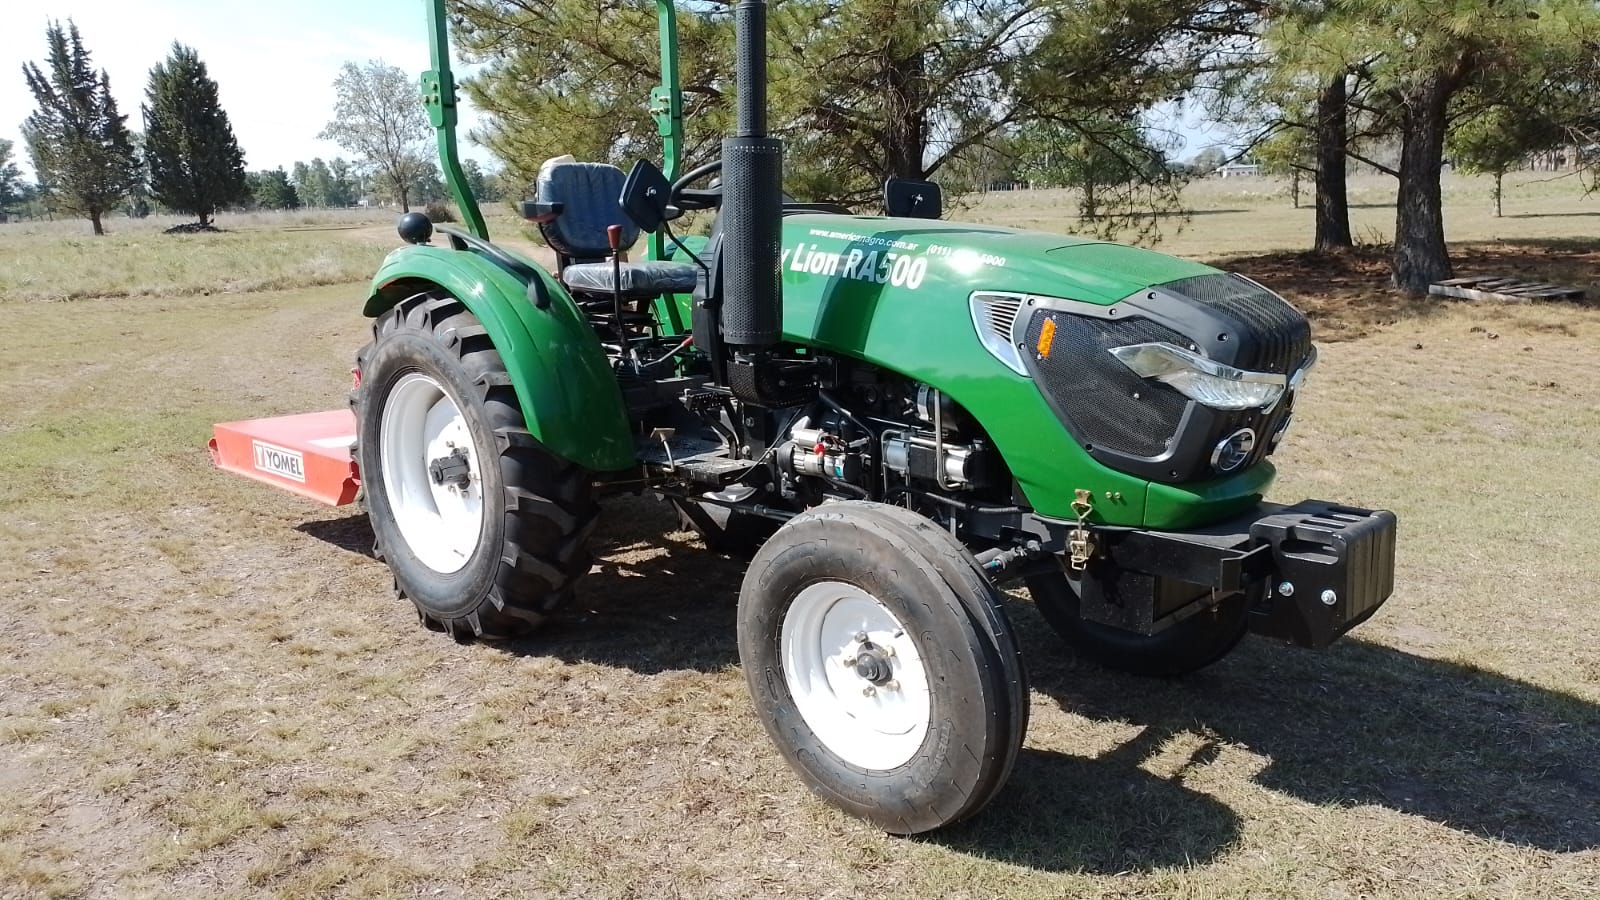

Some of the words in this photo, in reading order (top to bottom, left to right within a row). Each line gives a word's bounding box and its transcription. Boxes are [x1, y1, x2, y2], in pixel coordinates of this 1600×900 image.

[808, 228, 918, 250] www.americanagro.com.ar
[790, 242, 841, 276] Lion
[842, 248, 928, 290] RA500
[265, 449, 302, 475] YOMEL
